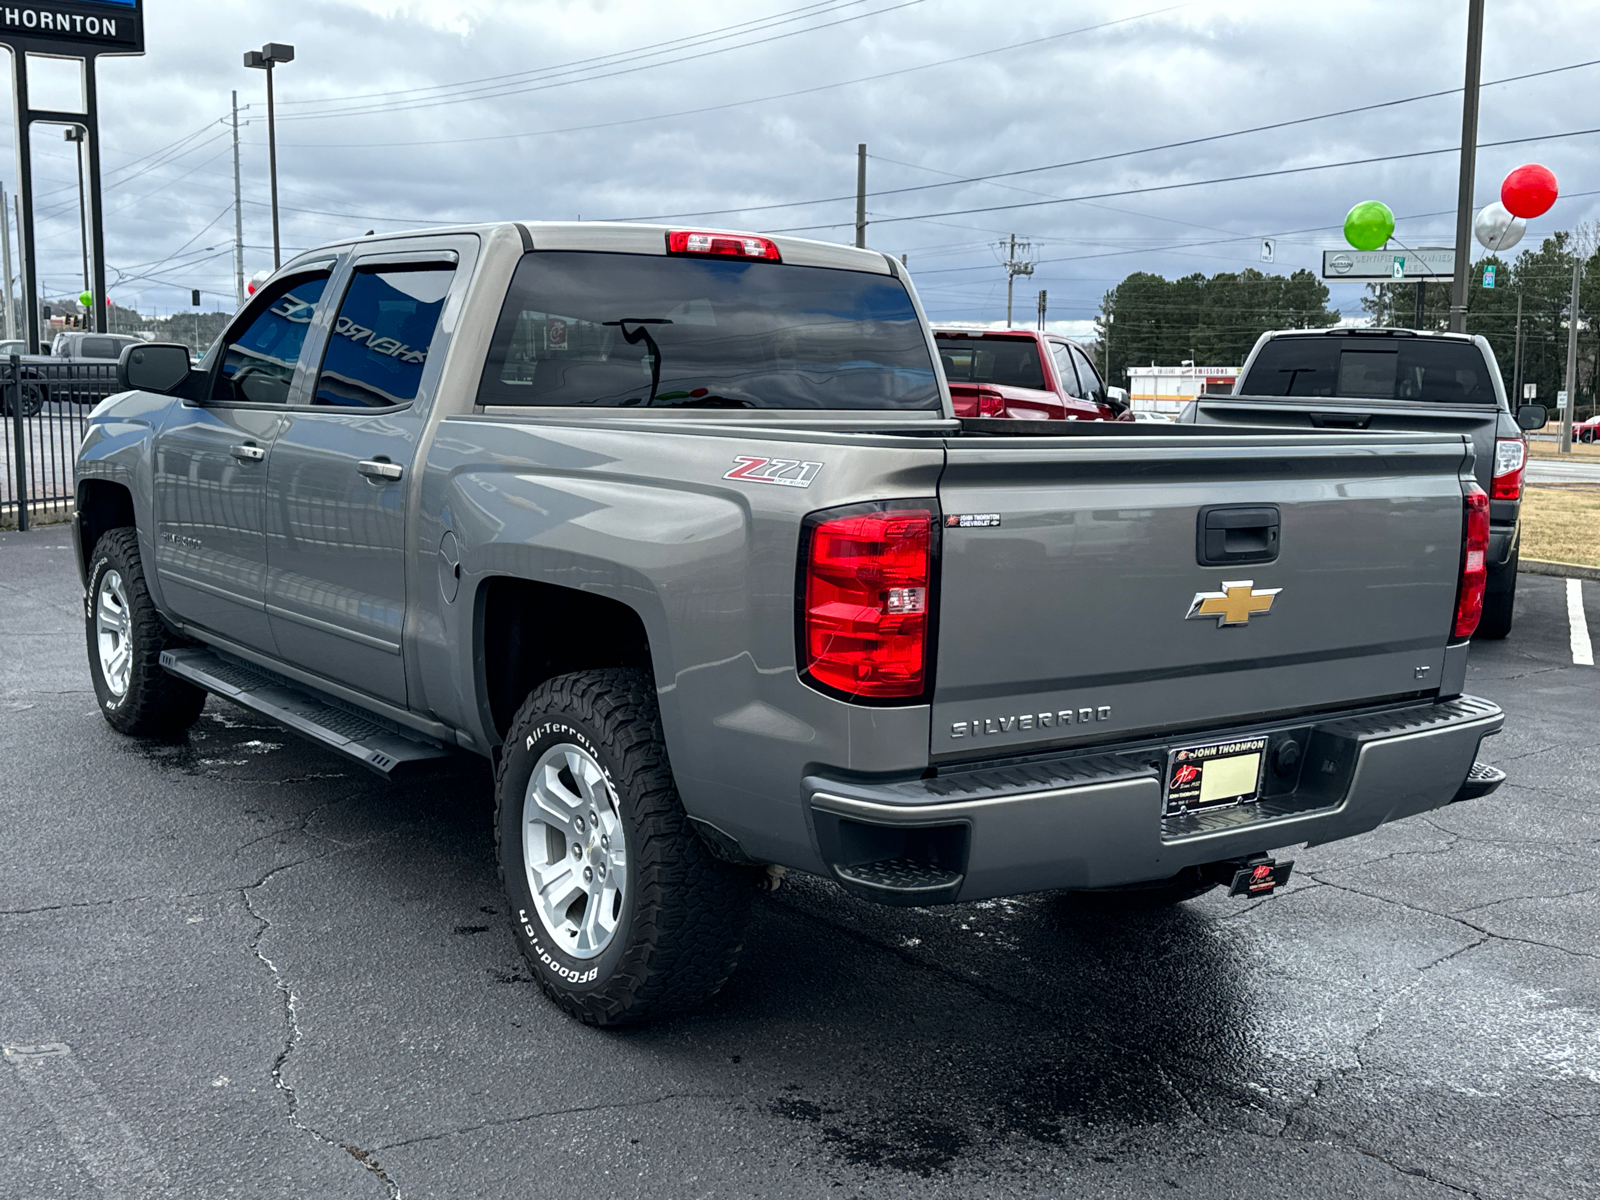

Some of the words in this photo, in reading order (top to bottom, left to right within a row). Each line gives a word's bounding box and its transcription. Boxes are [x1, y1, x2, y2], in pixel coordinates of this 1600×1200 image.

[722, 454, 825, 489] Z71
[951, 705, 1111, 738] SILVERADO
[1193, 746, 1217, 758] JOHN
[1218, 739, 1265, 755] THORNTON
[519, 909, 598, 983] BFGoodrich
